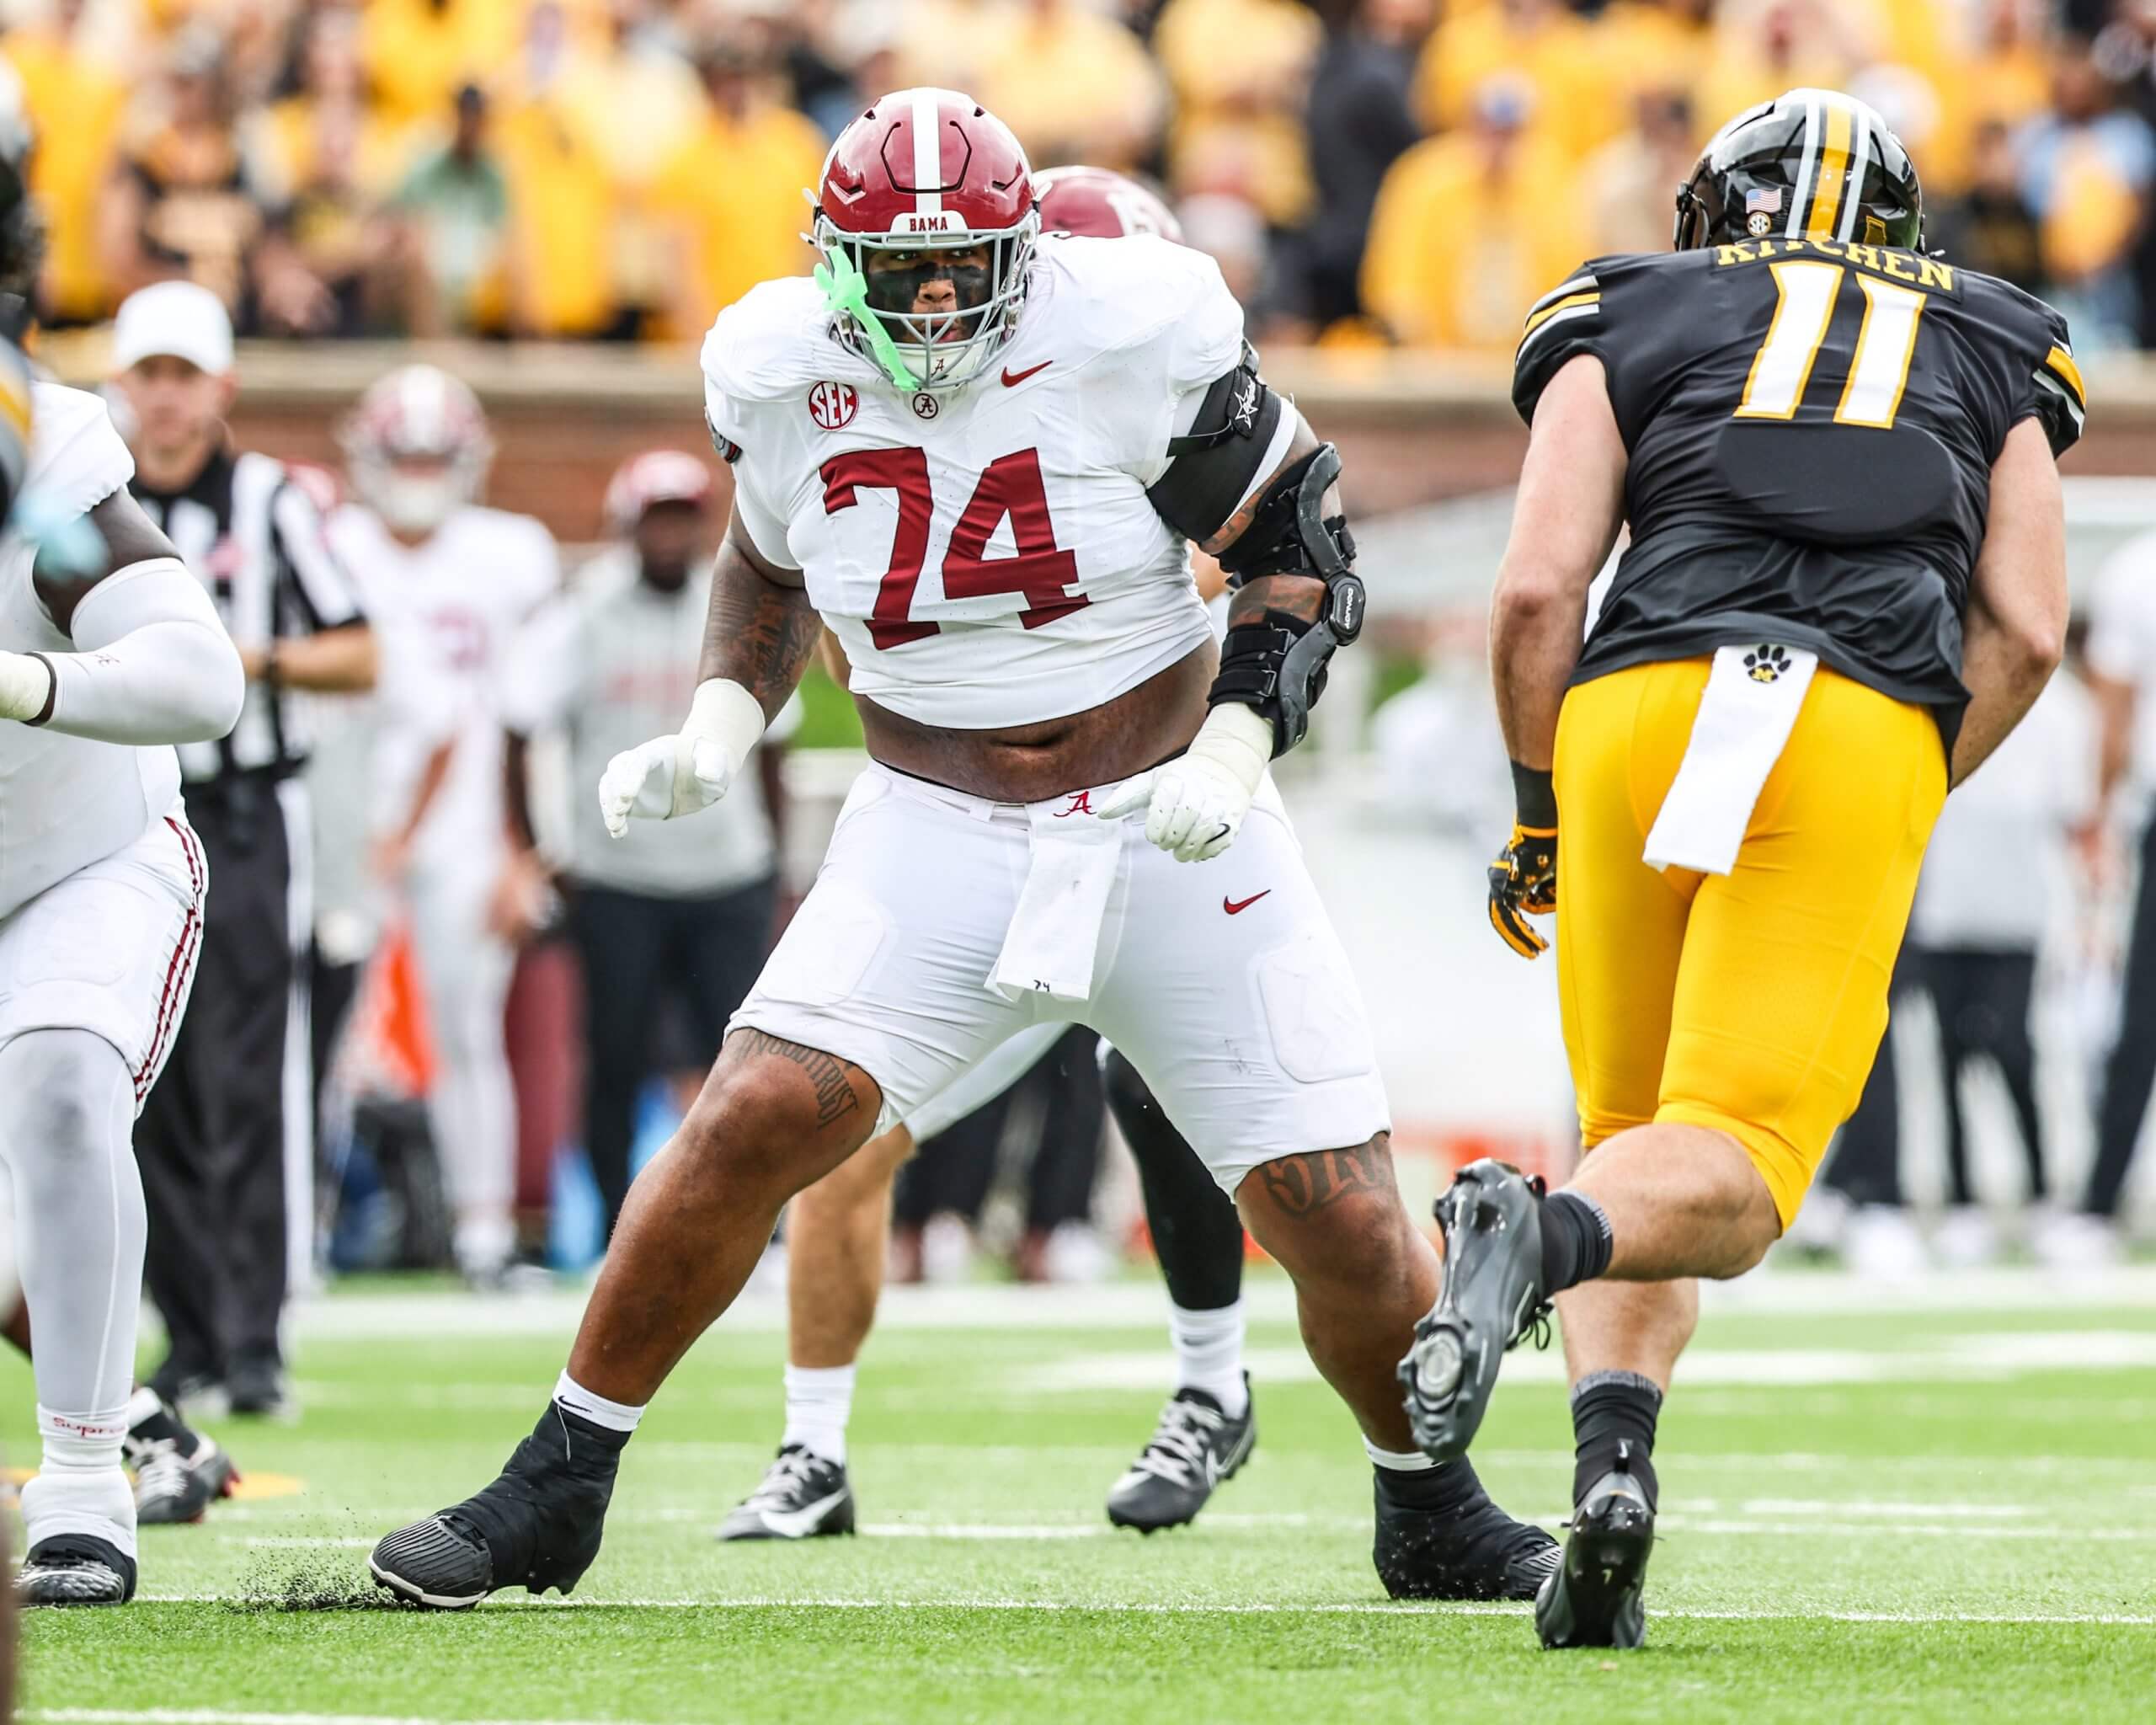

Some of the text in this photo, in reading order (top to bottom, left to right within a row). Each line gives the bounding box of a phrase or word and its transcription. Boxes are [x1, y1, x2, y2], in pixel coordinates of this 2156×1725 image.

[910, 216, 948, 232] BAMA
[1732, 259, 1927, 430] 11
[810, 381, 855, 428] SEC
[820, 446, 1092, 650] 74
[1053, 790, 1097, 817] A
[1033, 979, 1050, 992] 74
